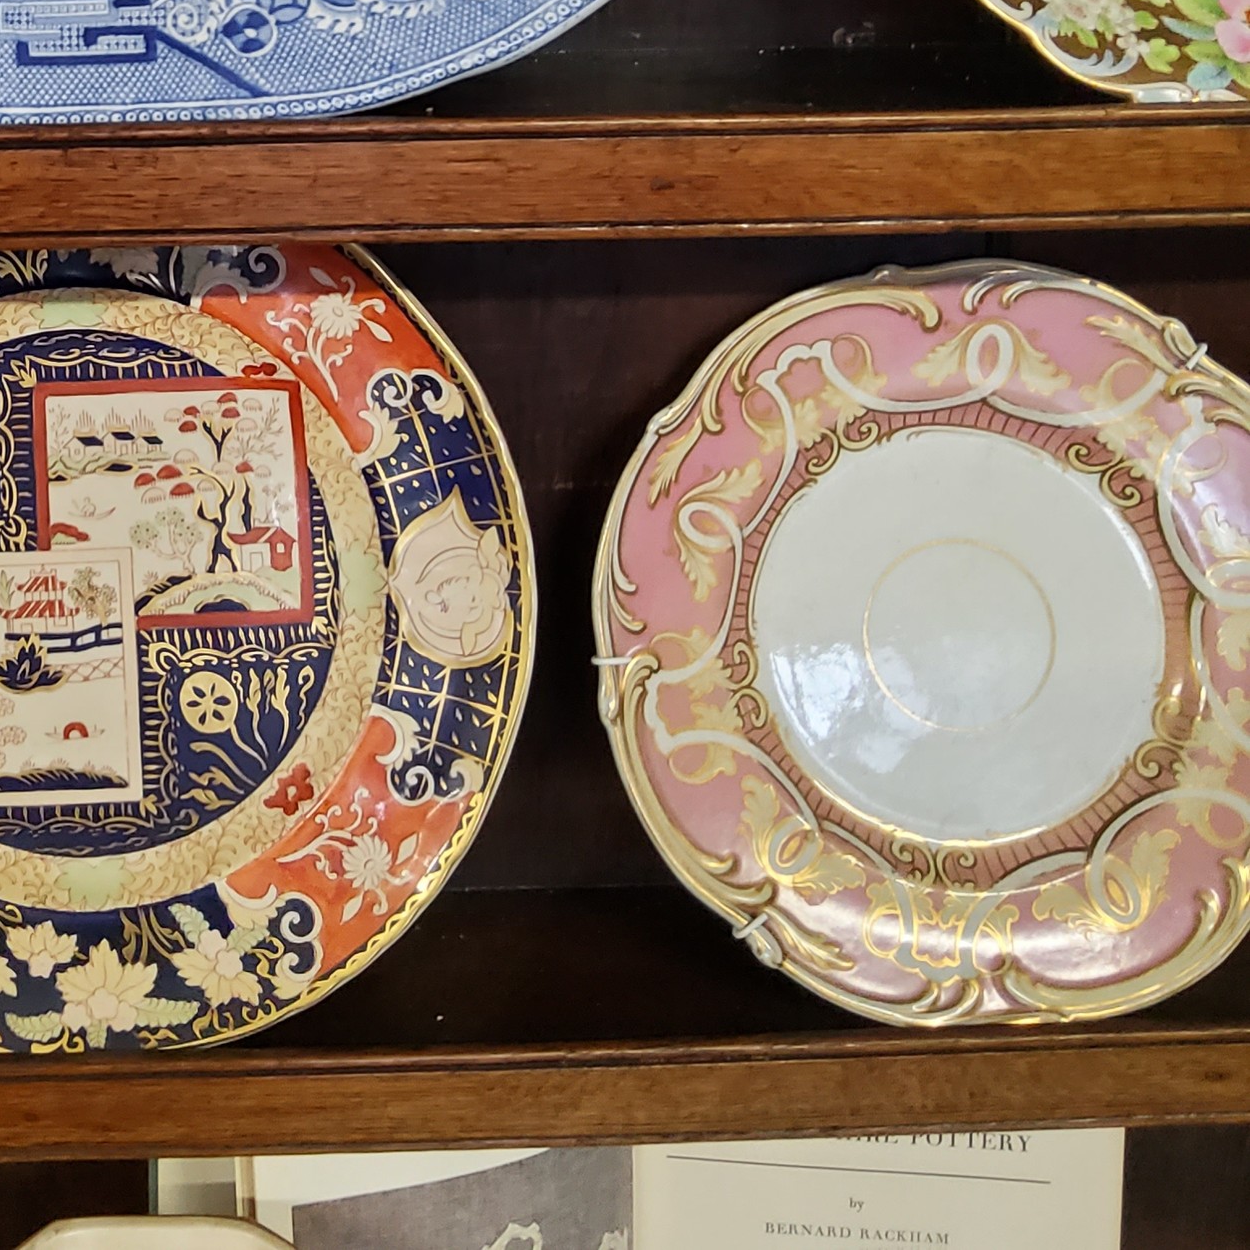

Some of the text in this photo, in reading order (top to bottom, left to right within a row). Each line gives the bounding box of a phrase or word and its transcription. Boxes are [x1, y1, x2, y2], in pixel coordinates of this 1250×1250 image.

[849, 1197, 864, 1213] by
[765, 1222, 949, 1244] BERNARD RACKHAM
